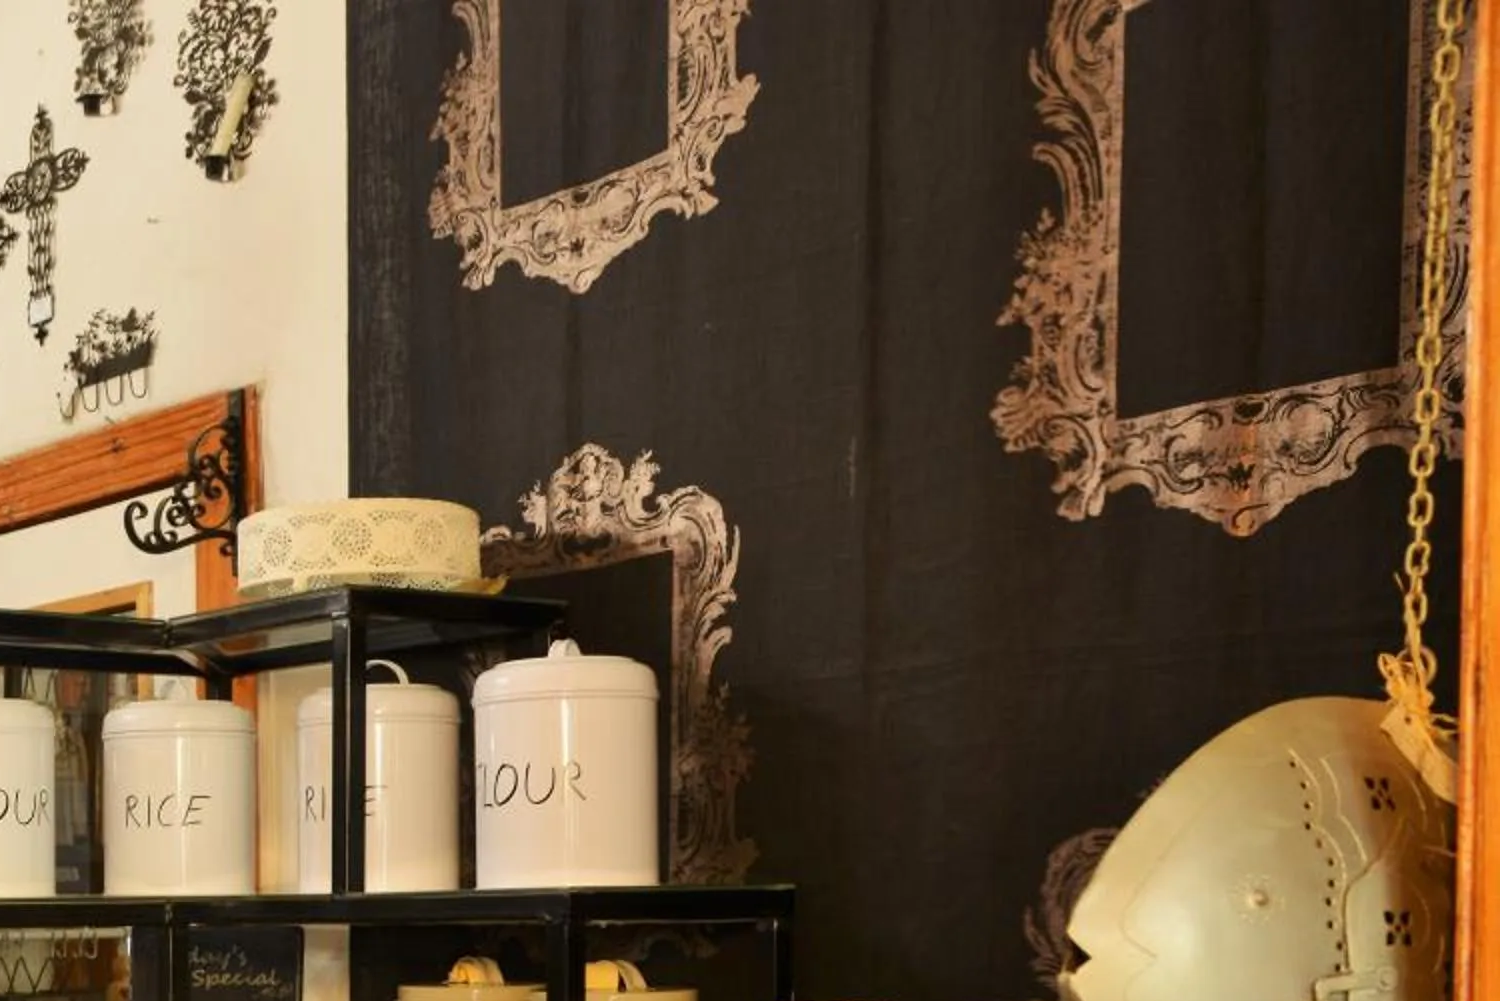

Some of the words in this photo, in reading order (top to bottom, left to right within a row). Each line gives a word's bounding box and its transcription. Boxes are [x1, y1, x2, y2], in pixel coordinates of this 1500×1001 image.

[478, 761, 587, 807] LOUR
[124, 793, 212, 829] RICE
[305, 784, 388, 822] RIE
[191, 968, 280, 991] Special
